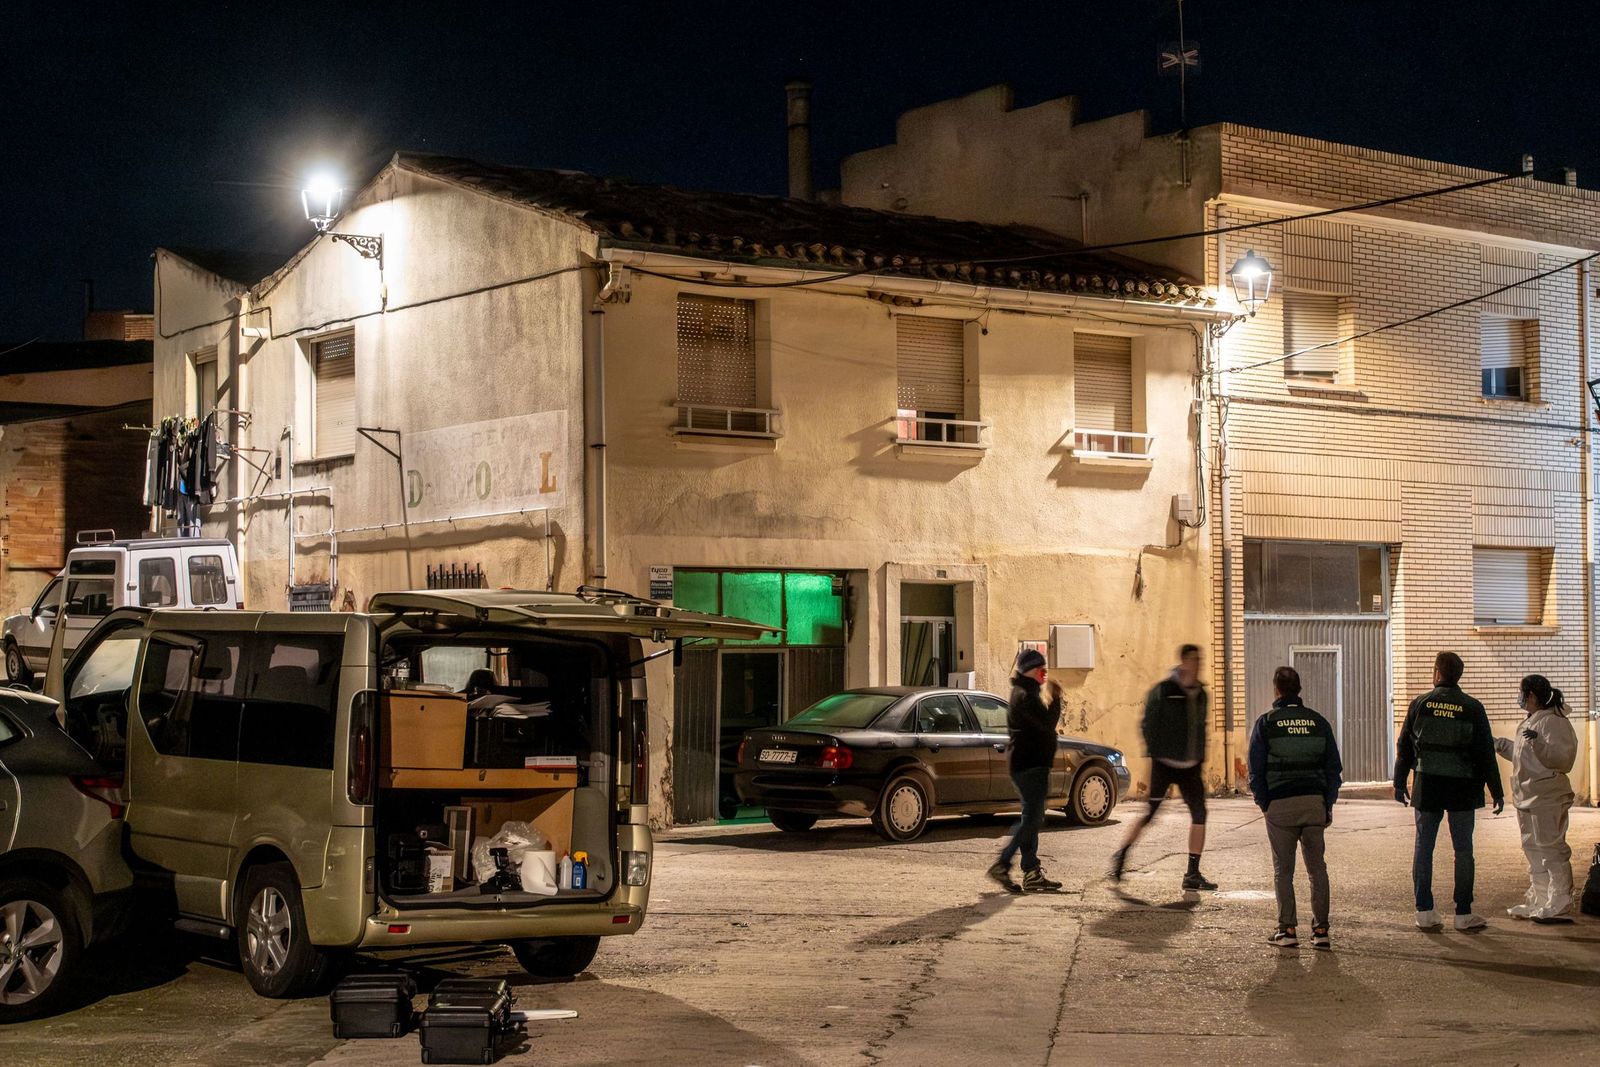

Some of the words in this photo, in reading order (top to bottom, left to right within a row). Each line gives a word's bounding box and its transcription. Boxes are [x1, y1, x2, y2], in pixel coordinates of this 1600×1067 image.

[538, 451, 557, 494] L
[1426, 701, 1463, 712] GUARDIA
[1433, 710, 1455, 718] CIVIL
[1277, 719, 1316, 727] GUARDIA
